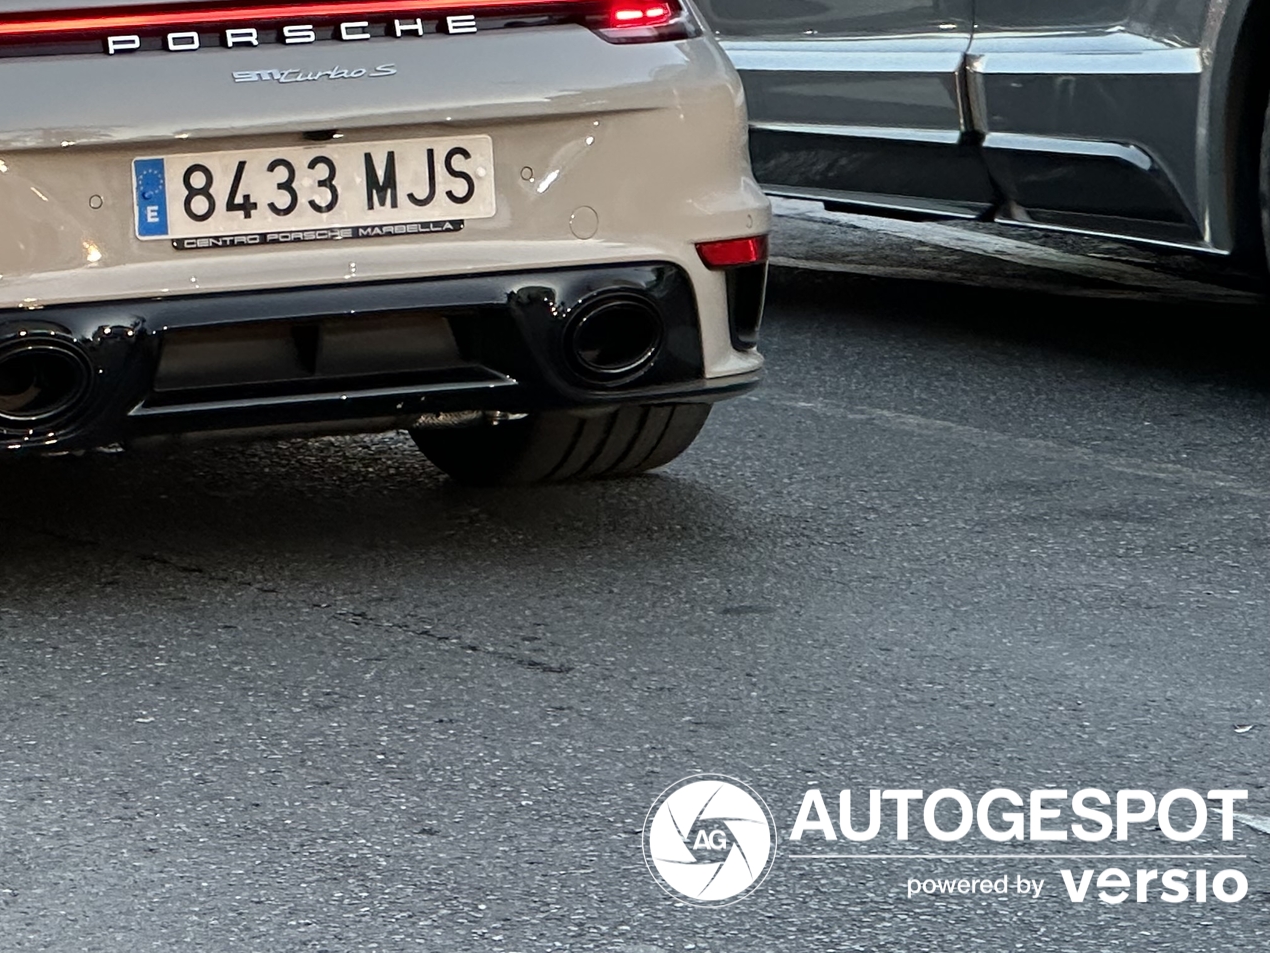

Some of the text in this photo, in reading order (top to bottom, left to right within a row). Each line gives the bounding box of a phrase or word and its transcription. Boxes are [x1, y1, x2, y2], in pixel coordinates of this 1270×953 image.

[108, 15, 477, 55] PORSCHE
[369, 63, 397, 77] S
[183, 147, 475, 222] 8433 MJS
[147, 205, 159, 223] E
[184, 221, 454, 248] CENTRO PORSCHE MARBELLA
